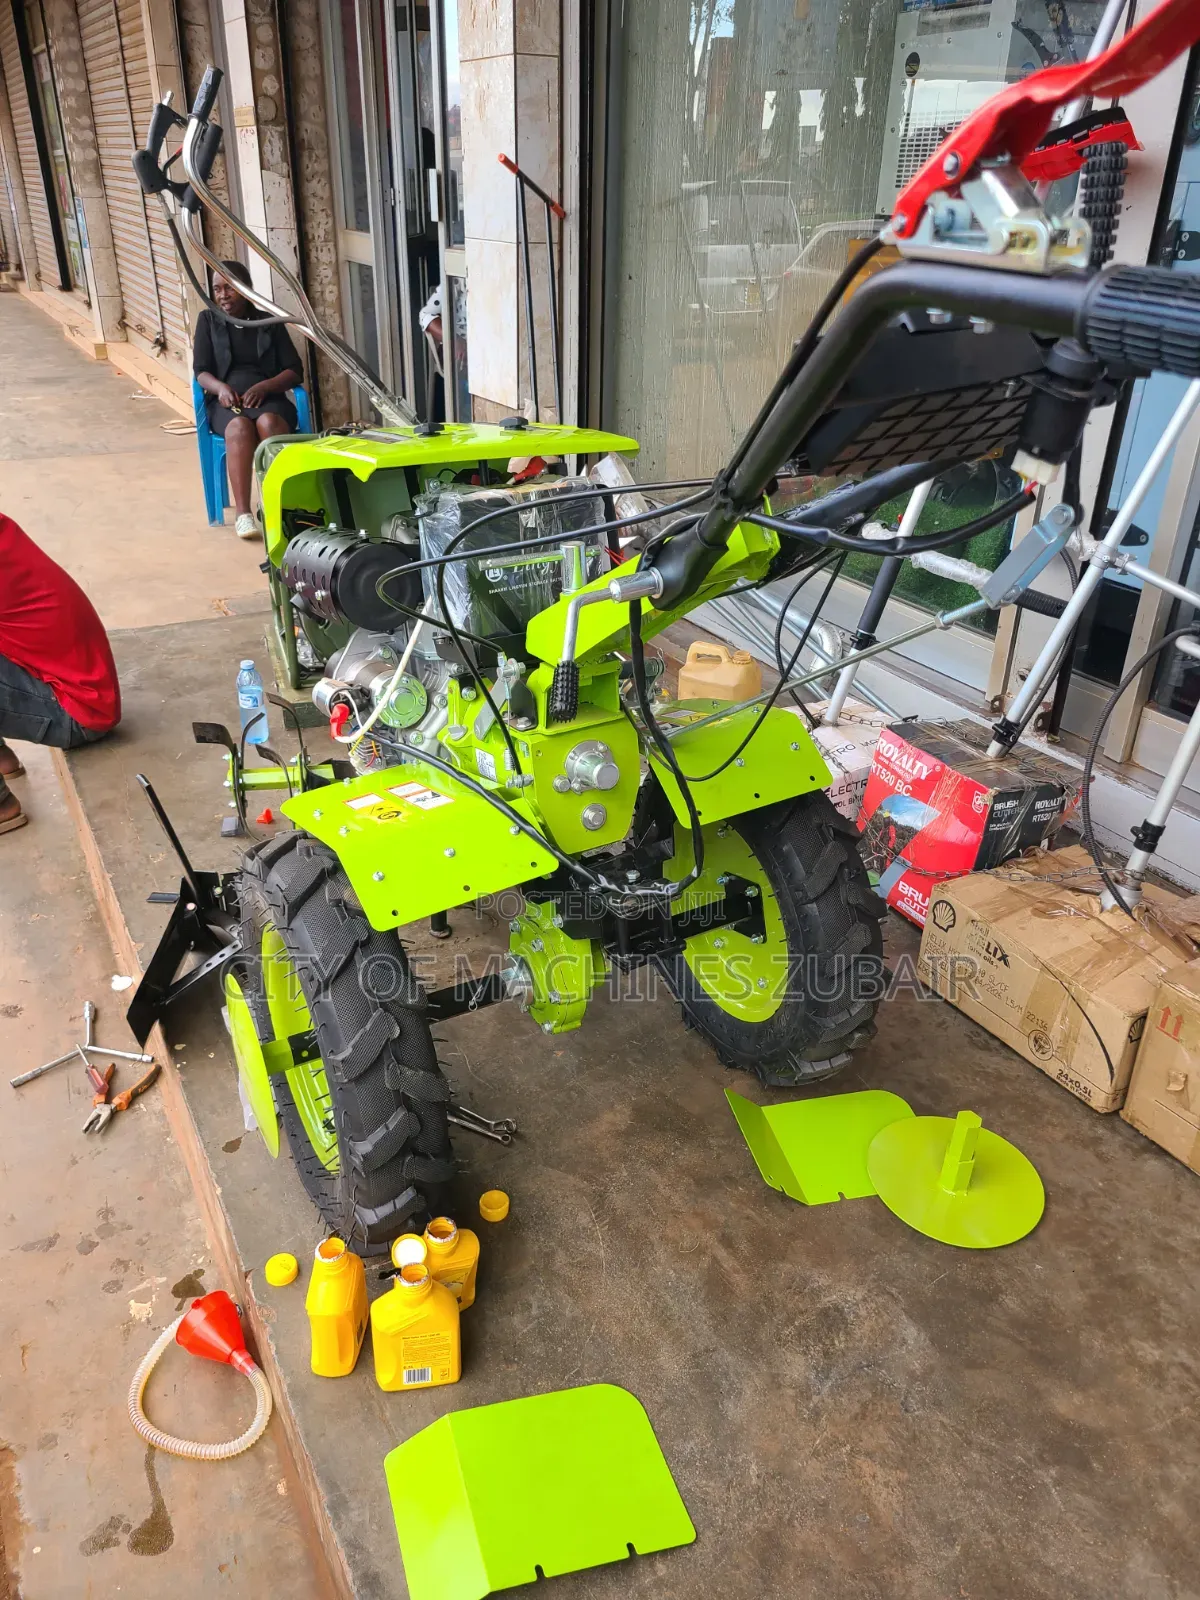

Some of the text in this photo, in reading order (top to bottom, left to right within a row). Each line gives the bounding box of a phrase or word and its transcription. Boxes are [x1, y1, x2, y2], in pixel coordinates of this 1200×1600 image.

[876, 737, 932, 781] ROYALTY
[871, 762, 913, 797] RT520 BC
[993, 799, 1020, 811] BRUSH
[1057, 1069, 1093, 1098] 24x0.5L
